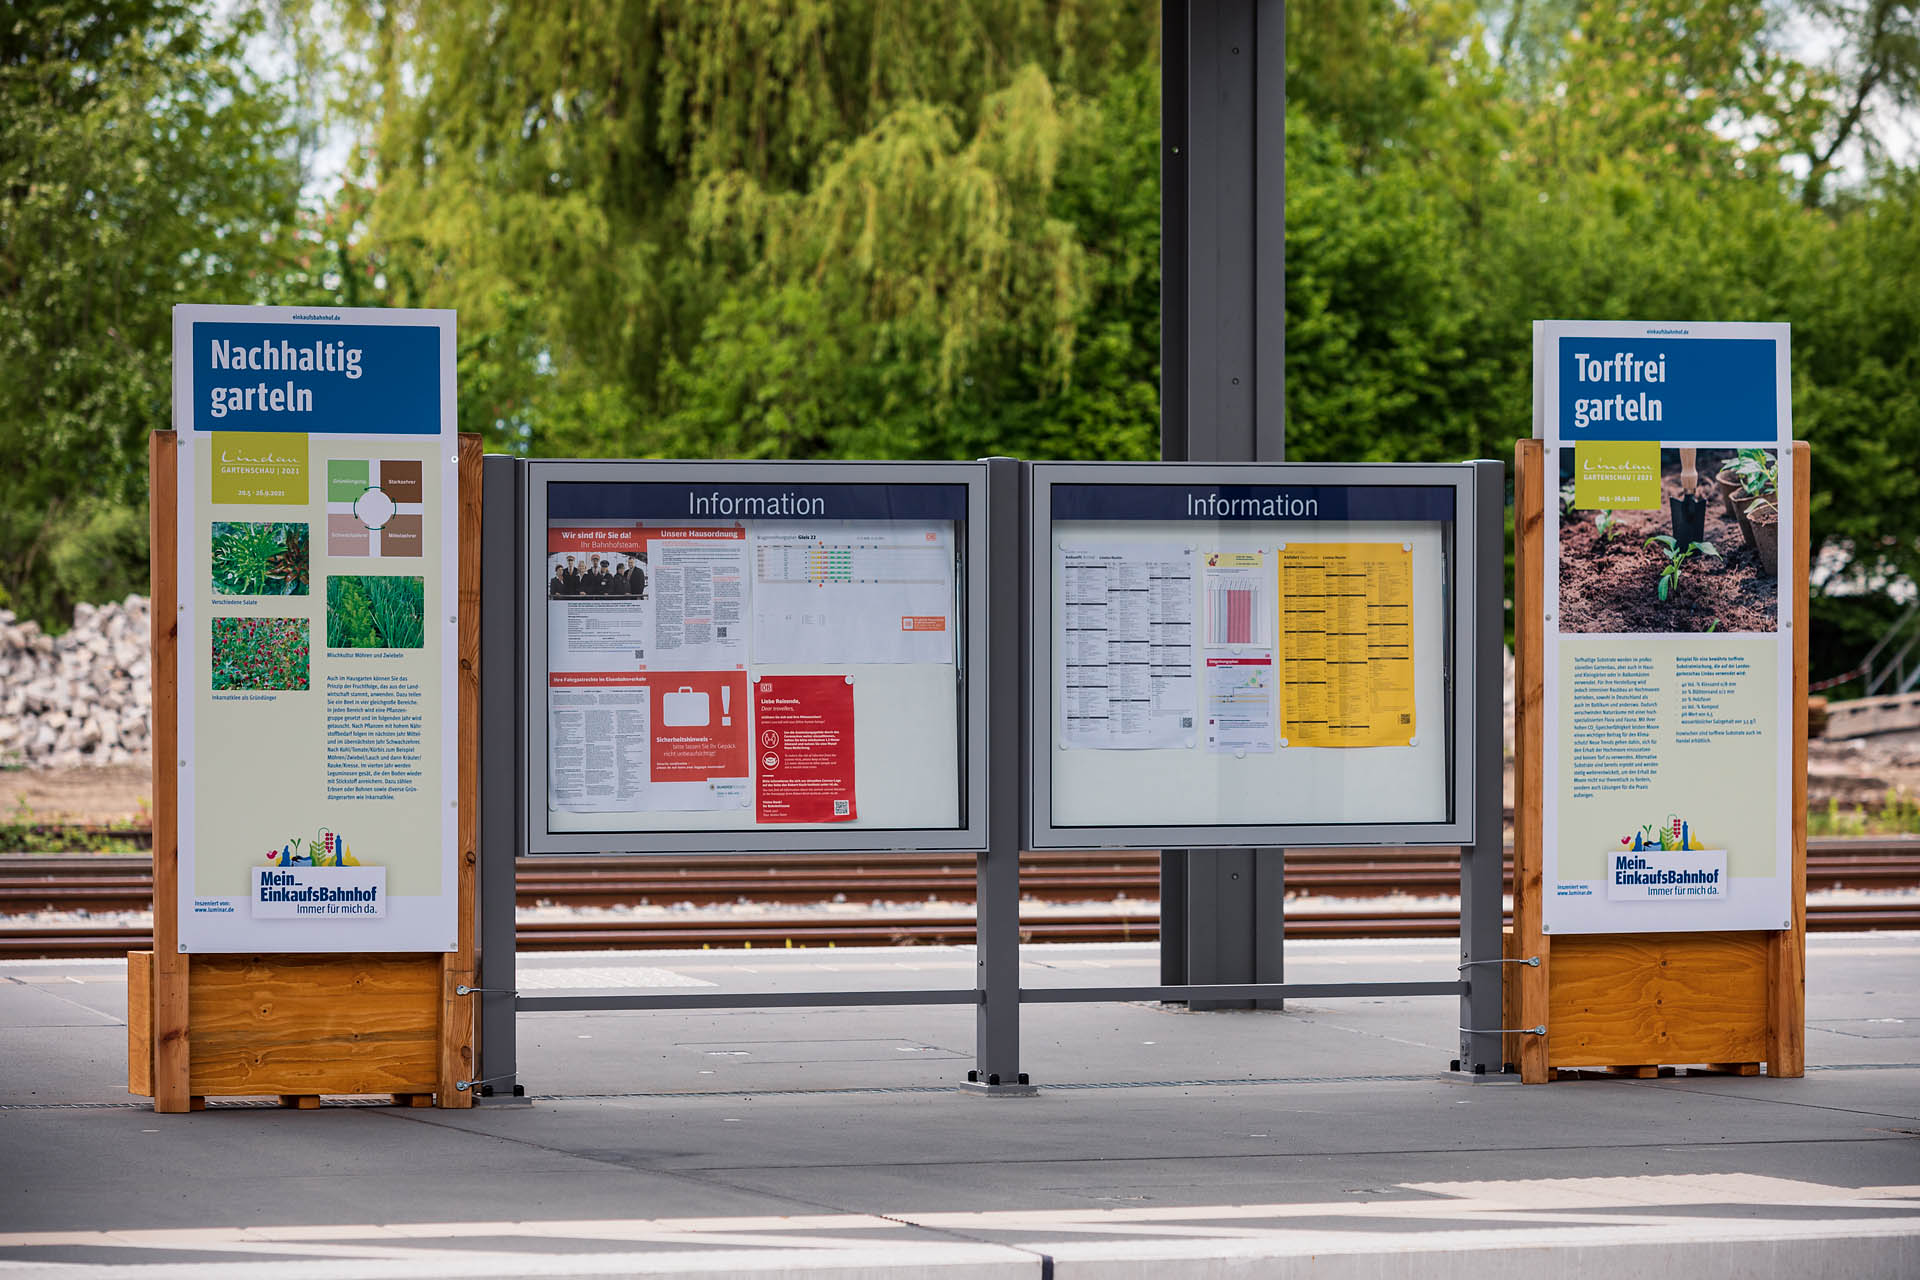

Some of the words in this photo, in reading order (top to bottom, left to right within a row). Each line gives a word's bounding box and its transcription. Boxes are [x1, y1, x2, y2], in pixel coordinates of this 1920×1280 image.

[212, 340, 362, 378] Nachhaltig
[1575, 353, 1665, 382] Torffrei
[211, 381, 312, 417] garteln
[1575, 393, 1662, 427] garteln
[221, 451, 300, 465] Lindau
[1584, 460, 1651, 471] Lindau
[222, 465, 274, 473] GARTENSCHAU
[281, 466, 299, 474] 2021
[690, 493, 824, 514] Information
[1188, 494, 1317, 515] Information
[688, 529, 739, 539] Hausordnung
[1616, 856, 1653, 870] Mein_
[261, 871, 302, 886] Mein_
[1616, 869, 1719, 885] EinkaufsBahnhof
[261, 887, 377, 902] EinkaufsBahnhof
[1648, 887, 1672, 896] Immer
[1675, 886, 1685, 895] für
[1687, 886, 1706, 895] mich
[1707, 886, 1719, 895] da.
[297, 904, 325, 914] Immer
[327, 904, 339, 914] für
[341, 904, 362, 914] mich
[364, 904, 377, 914] da.
